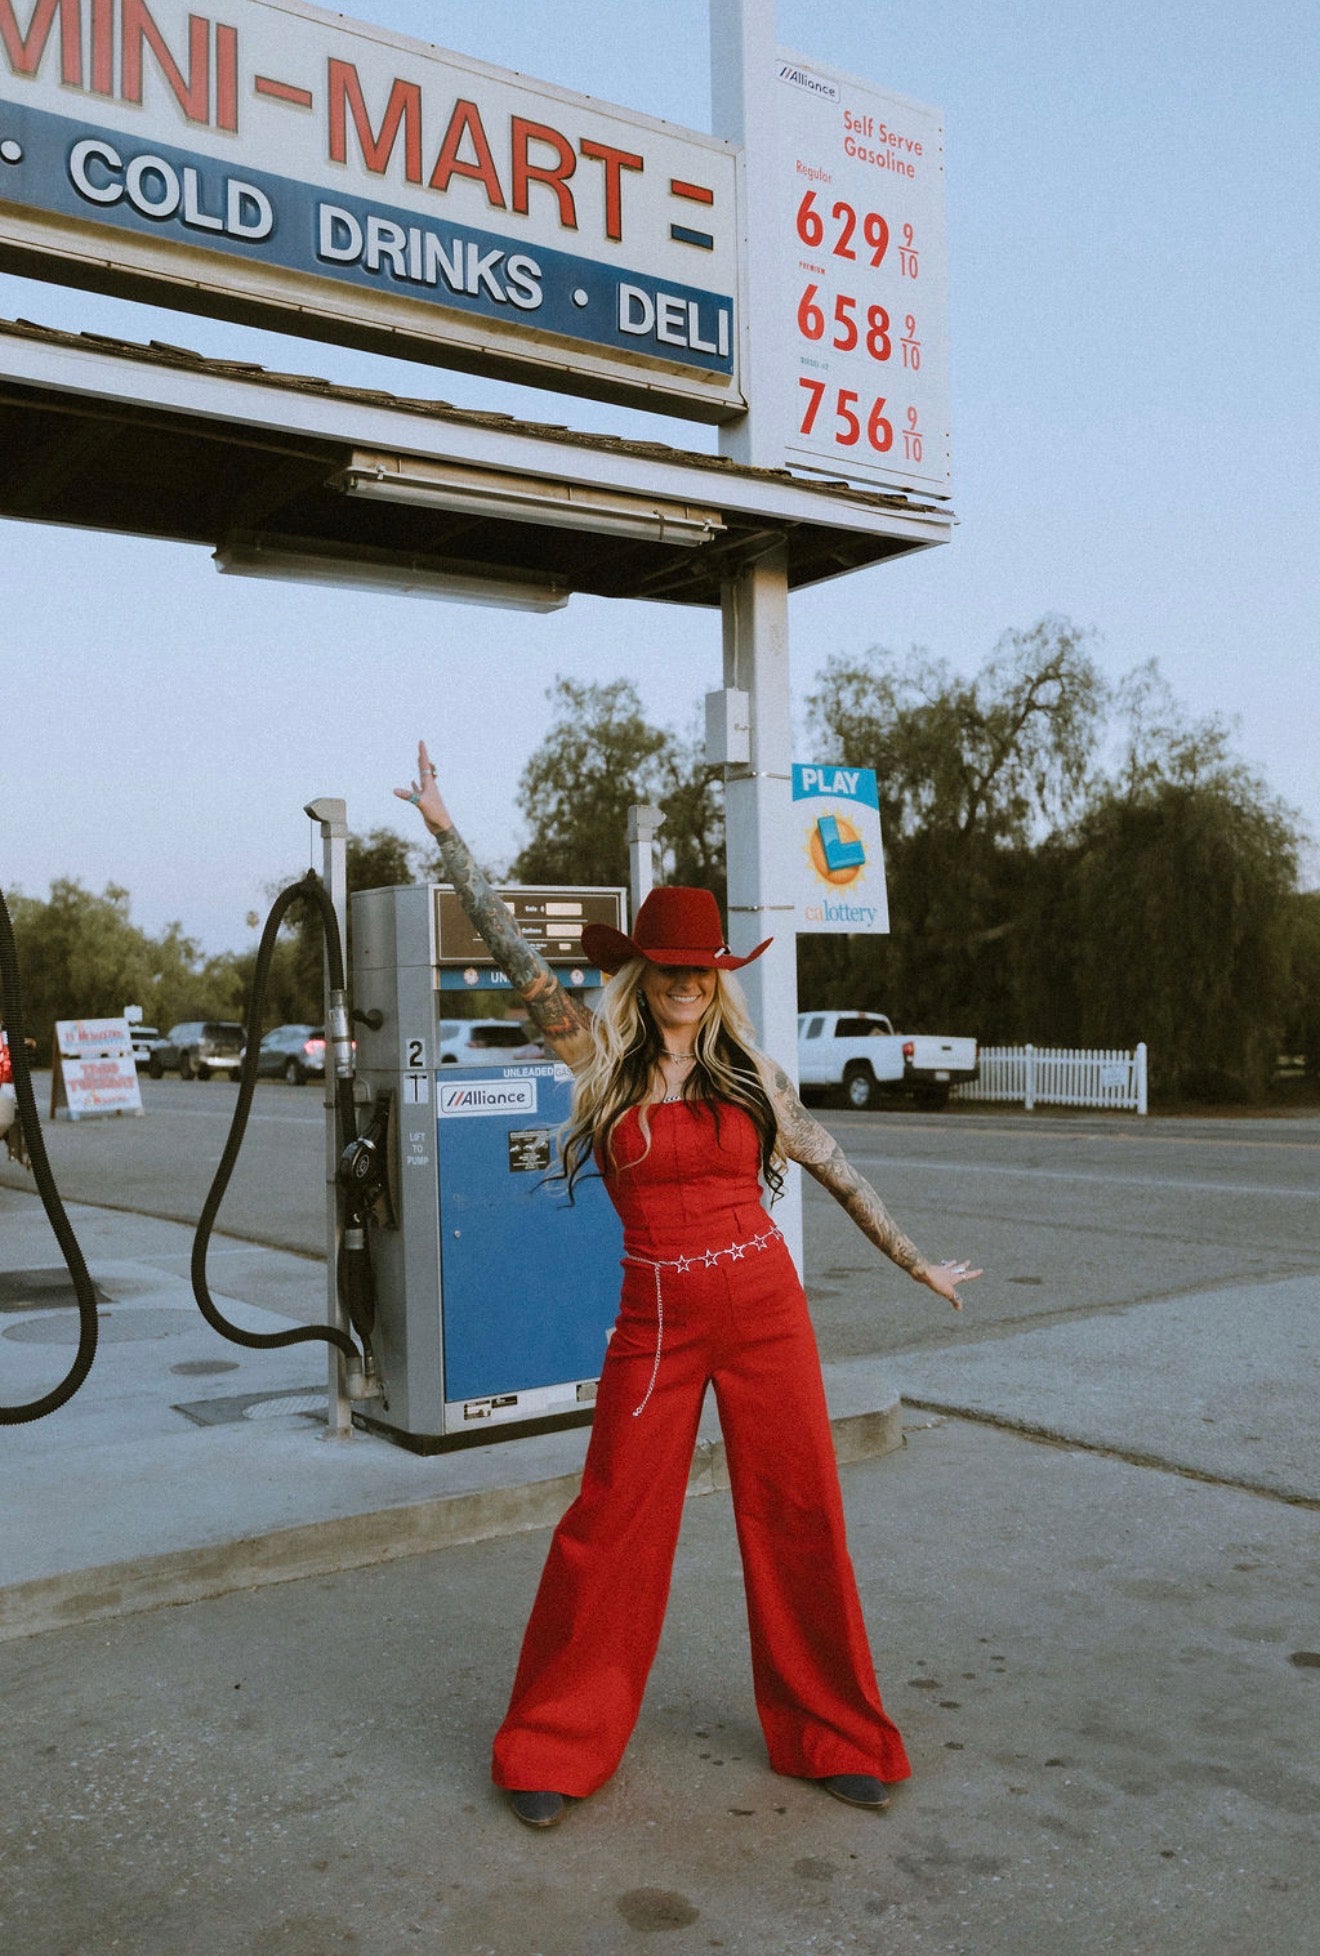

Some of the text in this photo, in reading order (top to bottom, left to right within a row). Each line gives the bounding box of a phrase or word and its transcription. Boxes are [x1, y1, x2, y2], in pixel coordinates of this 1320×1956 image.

[0, 0, 644, 242] MINI-MART
[843, 110, 923, 156] Self Serve
[796, 159, 832, 184] Regular
[843, 136, 915, 178] Gasoline
[796, 190, 890, 268] 629
[69, 139, 729, 356] COLD DRINKS DELI
[797, 283, 892, 361] 658
[799, 376, 893, 453] 756
[801, 767, 860, 795] PLAY
[409, 1040, 424, 1067] 2
[503, 1066, 554, 1078] UNLEADED
[409, 1132, 426, 1142] LIFT
[412, 1144, 423, 1153] TO
[406, 1155, 429, 1166] PUMP
